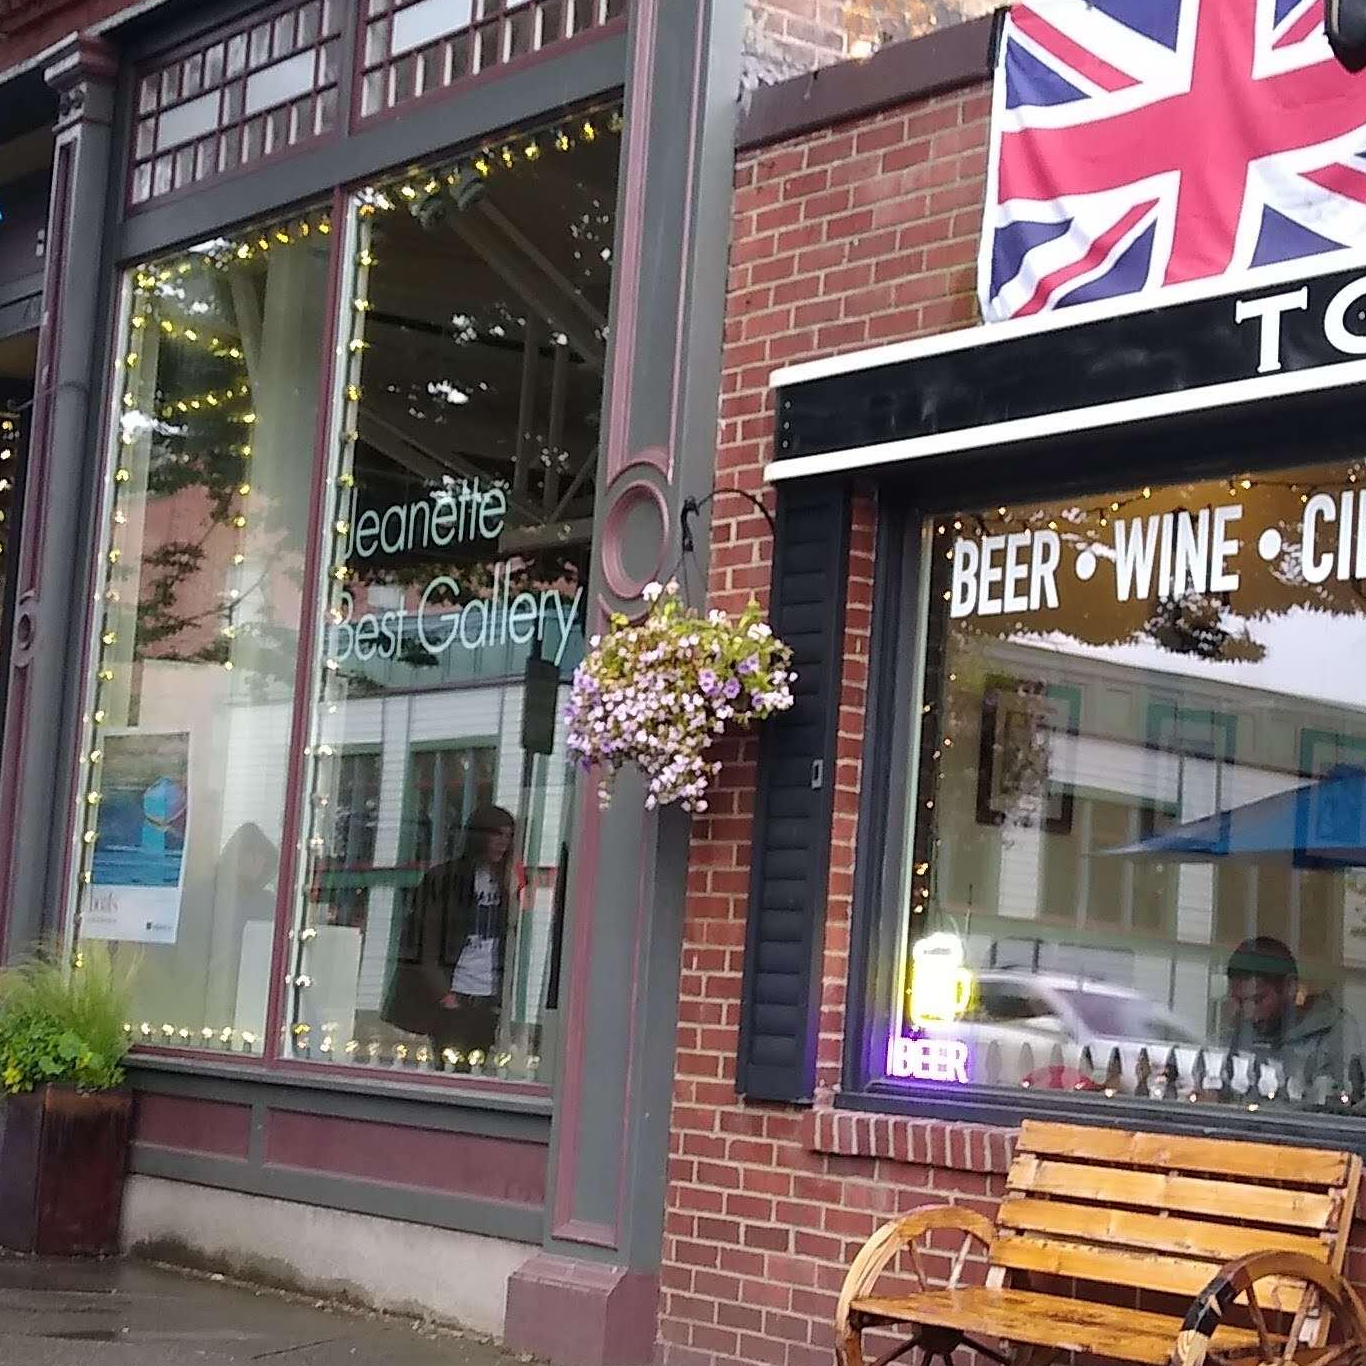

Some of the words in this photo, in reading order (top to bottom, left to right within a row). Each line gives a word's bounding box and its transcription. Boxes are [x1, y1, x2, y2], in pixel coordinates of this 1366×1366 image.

[344, 477, 507, 560] Jeanette
[949, 529, 1060, 619] BEER
[1114, 503, 1243, 602] WINE
[327, 590, 408, 663] Best
[417, 561, 583, 666] Gallery
[894, 1036, 969, 1084] BEER
